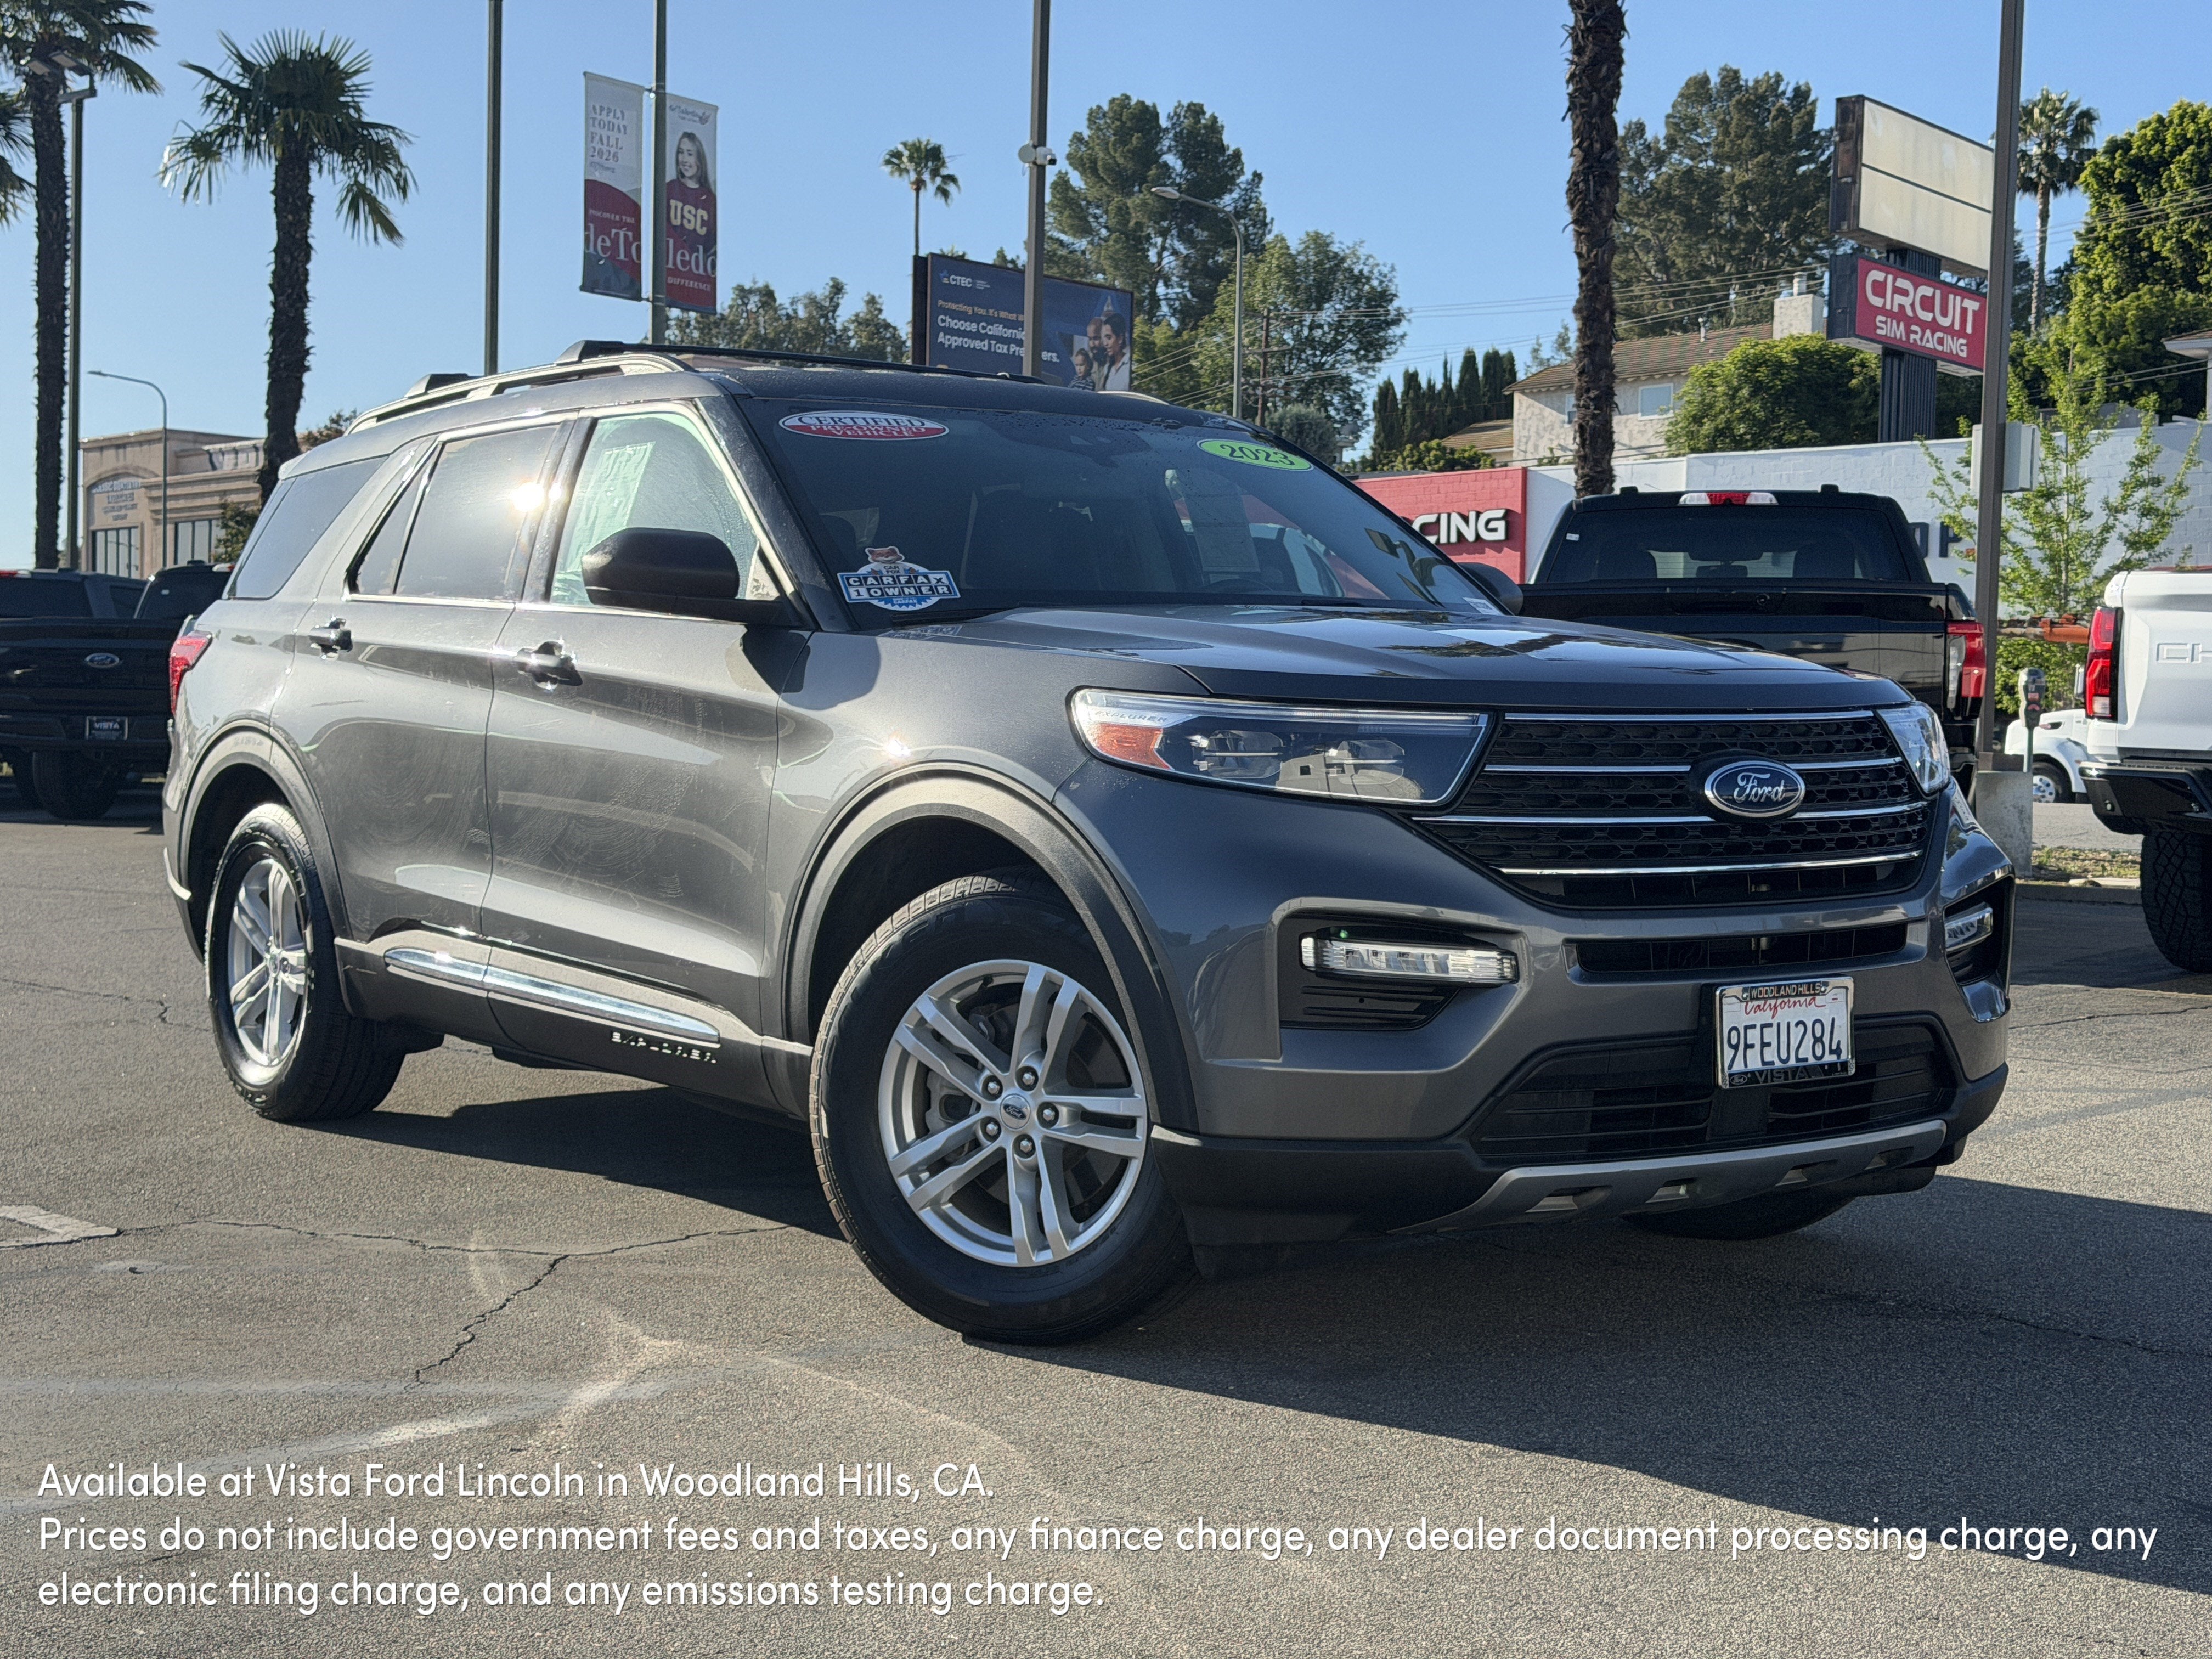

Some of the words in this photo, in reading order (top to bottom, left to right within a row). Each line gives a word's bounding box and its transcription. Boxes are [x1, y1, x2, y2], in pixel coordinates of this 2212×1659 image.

[591, 104, 625, 121] APPLY
[589, 117, 628, 136] TODAY
[590, 131, 624, 150] FALL
[590, 146, 619, 163] 2026
[669, 198, 709, 236] USC
[949, 274, 973, 287] CTEC
[1865, 269, 1980, 335] CIRCUIT
[937, 315, 978, 332] Choose
[937, 331, 989, 351] Approved
[989, 340, 1009, 354] Tax
[1875, 315, 1906, 342] SIM
[1909, 325, 1967, 358] RACING
[797, 416, 926, 427] CERTIFIED
[810, 424, 927, 433] PRE-OWNED
[1219, 444, 1295, 466] 2023
[848, 575, 946, 586] CARFAX
[869, 586, 950, 597] OWNER
[1733, 772, 1786, 803] Ford
[1751, 984, 1797, 998] WOODLAND
[1798, 983, 1821, 995] HILLS
[1744, 996, 1827, 1020] California
[1726, 1017, 1843, 1070] 9FEU284
[1006, 1105, 1023, 1118] Ford
